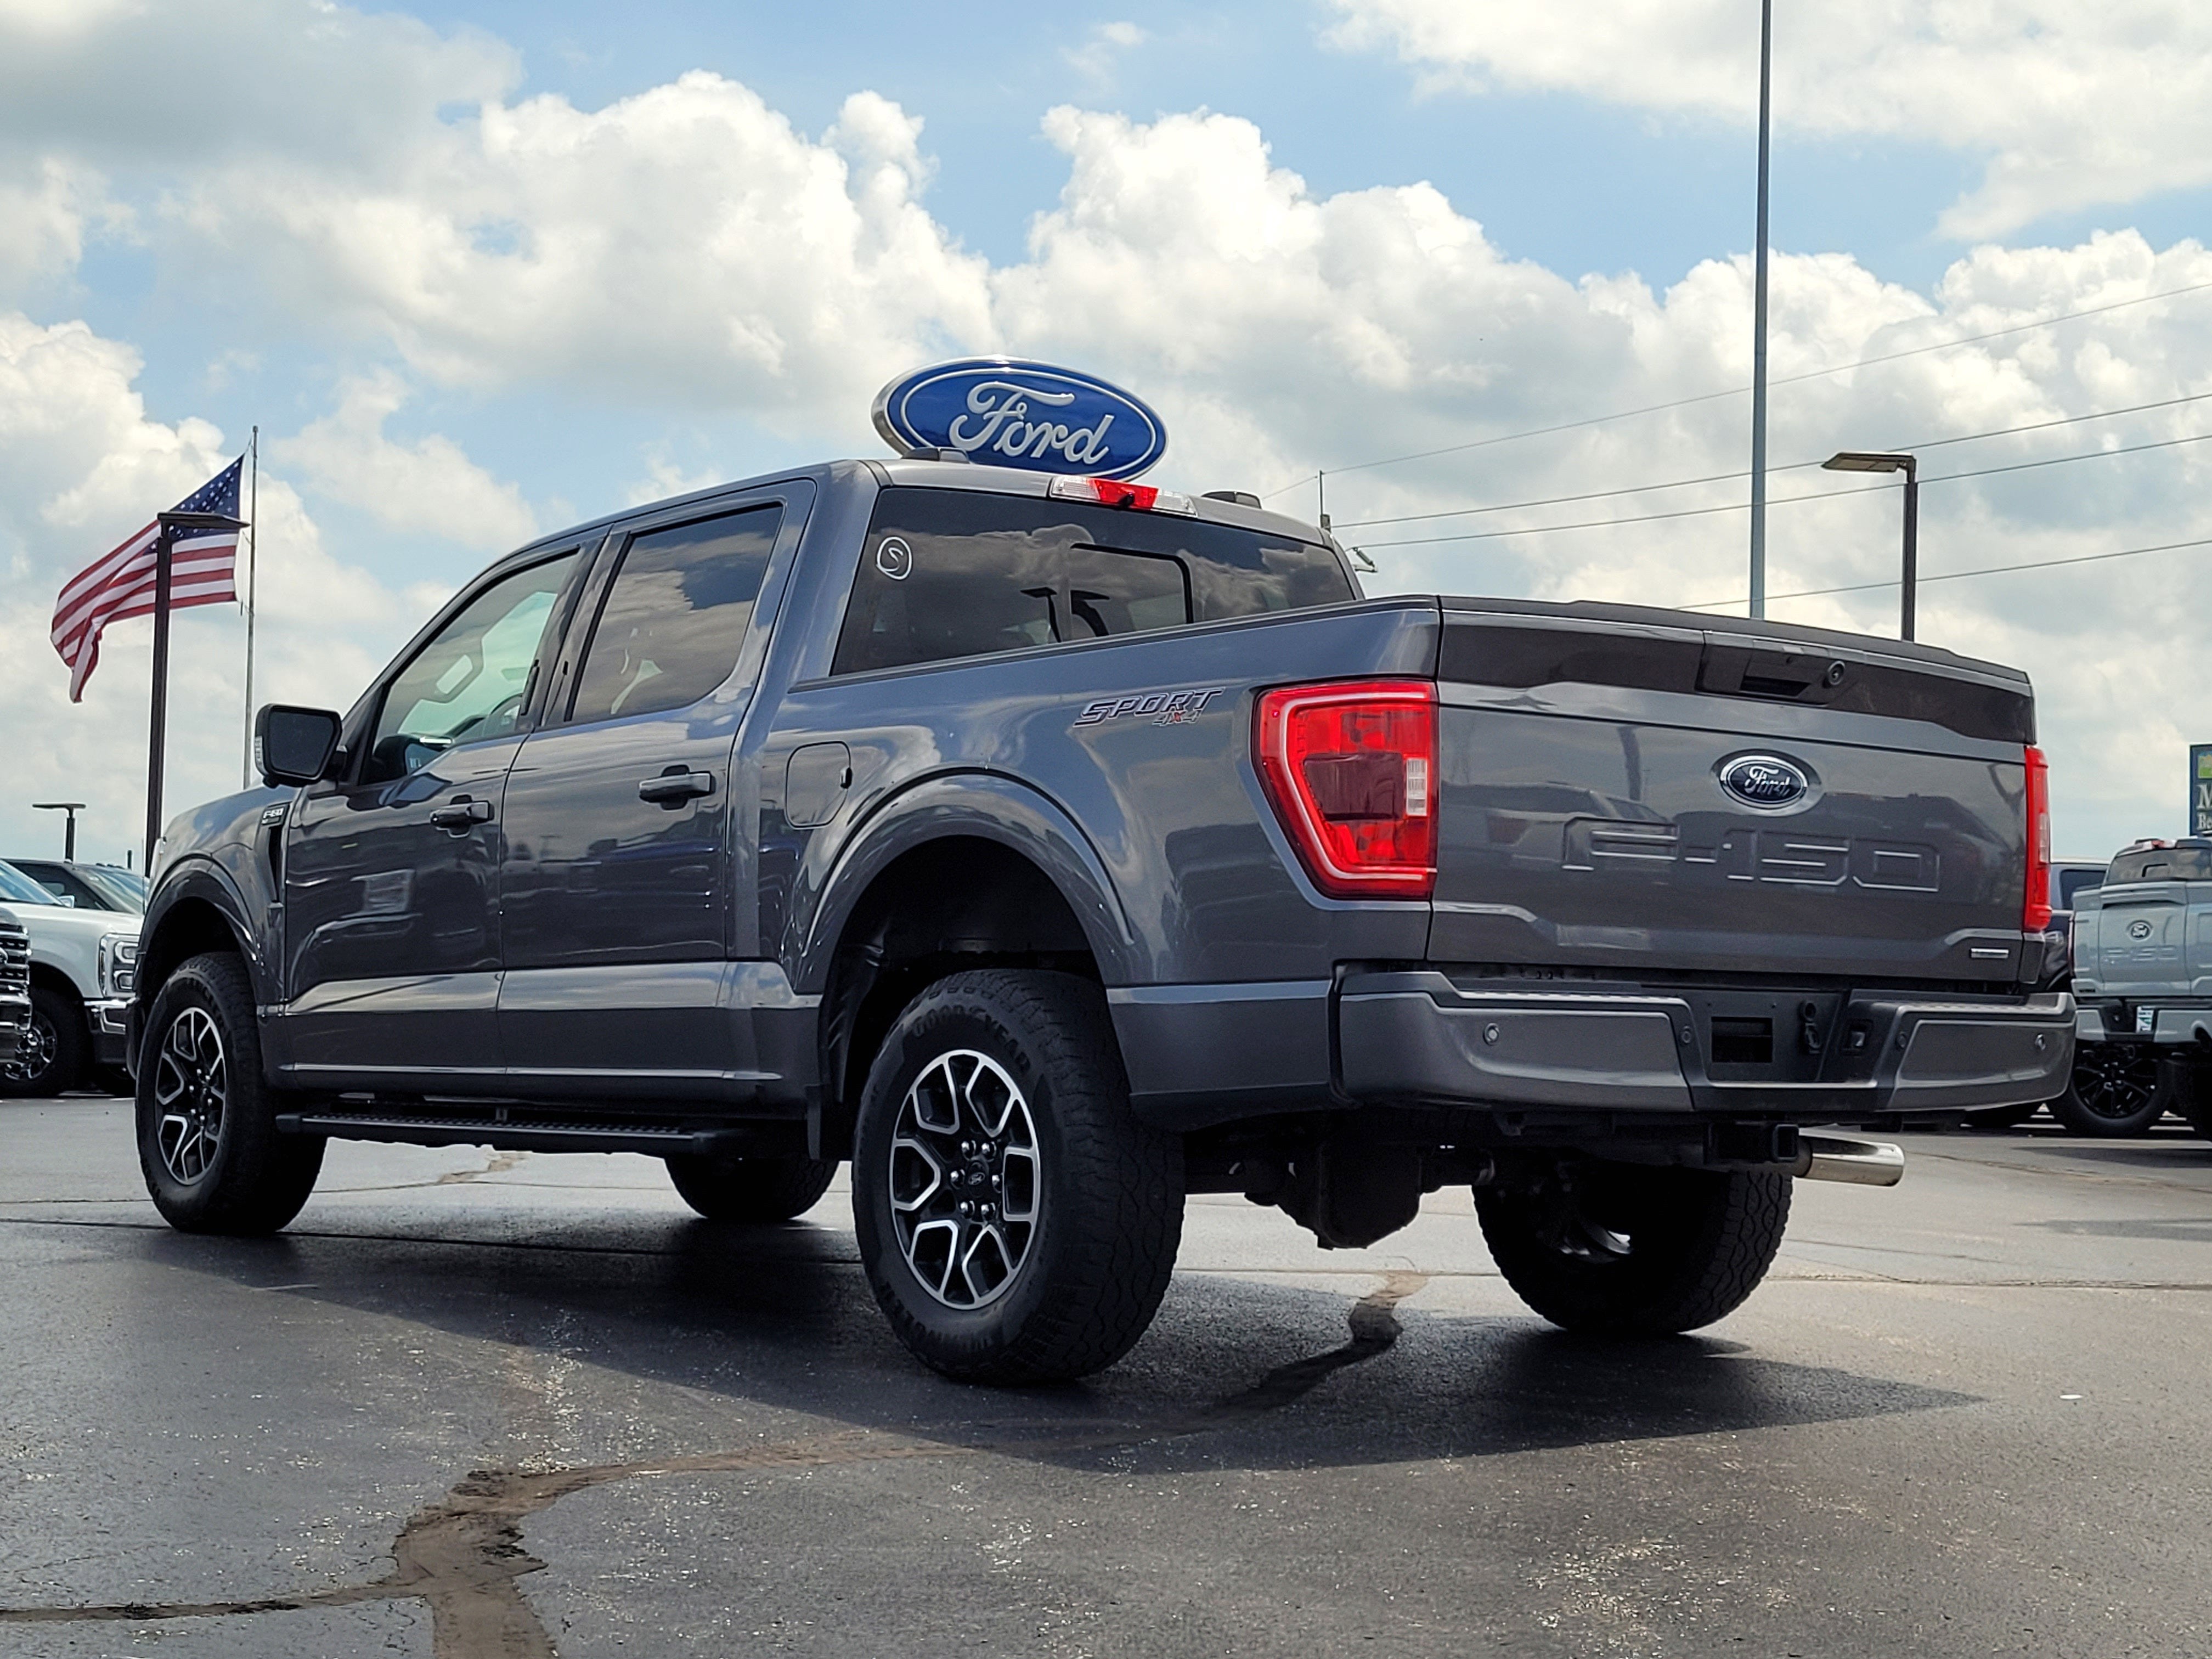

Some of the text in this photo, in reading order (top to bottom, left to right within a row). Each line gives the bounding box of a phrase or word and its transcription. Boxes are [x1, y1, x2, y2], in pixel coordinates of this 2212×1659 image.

[949, 381, 1115, 465] Ford
[1073, 687, 1226, 728] SPORT
[1745, 765, 1791, 797] Ford
[1561, 816, 1942, 893] F-150
